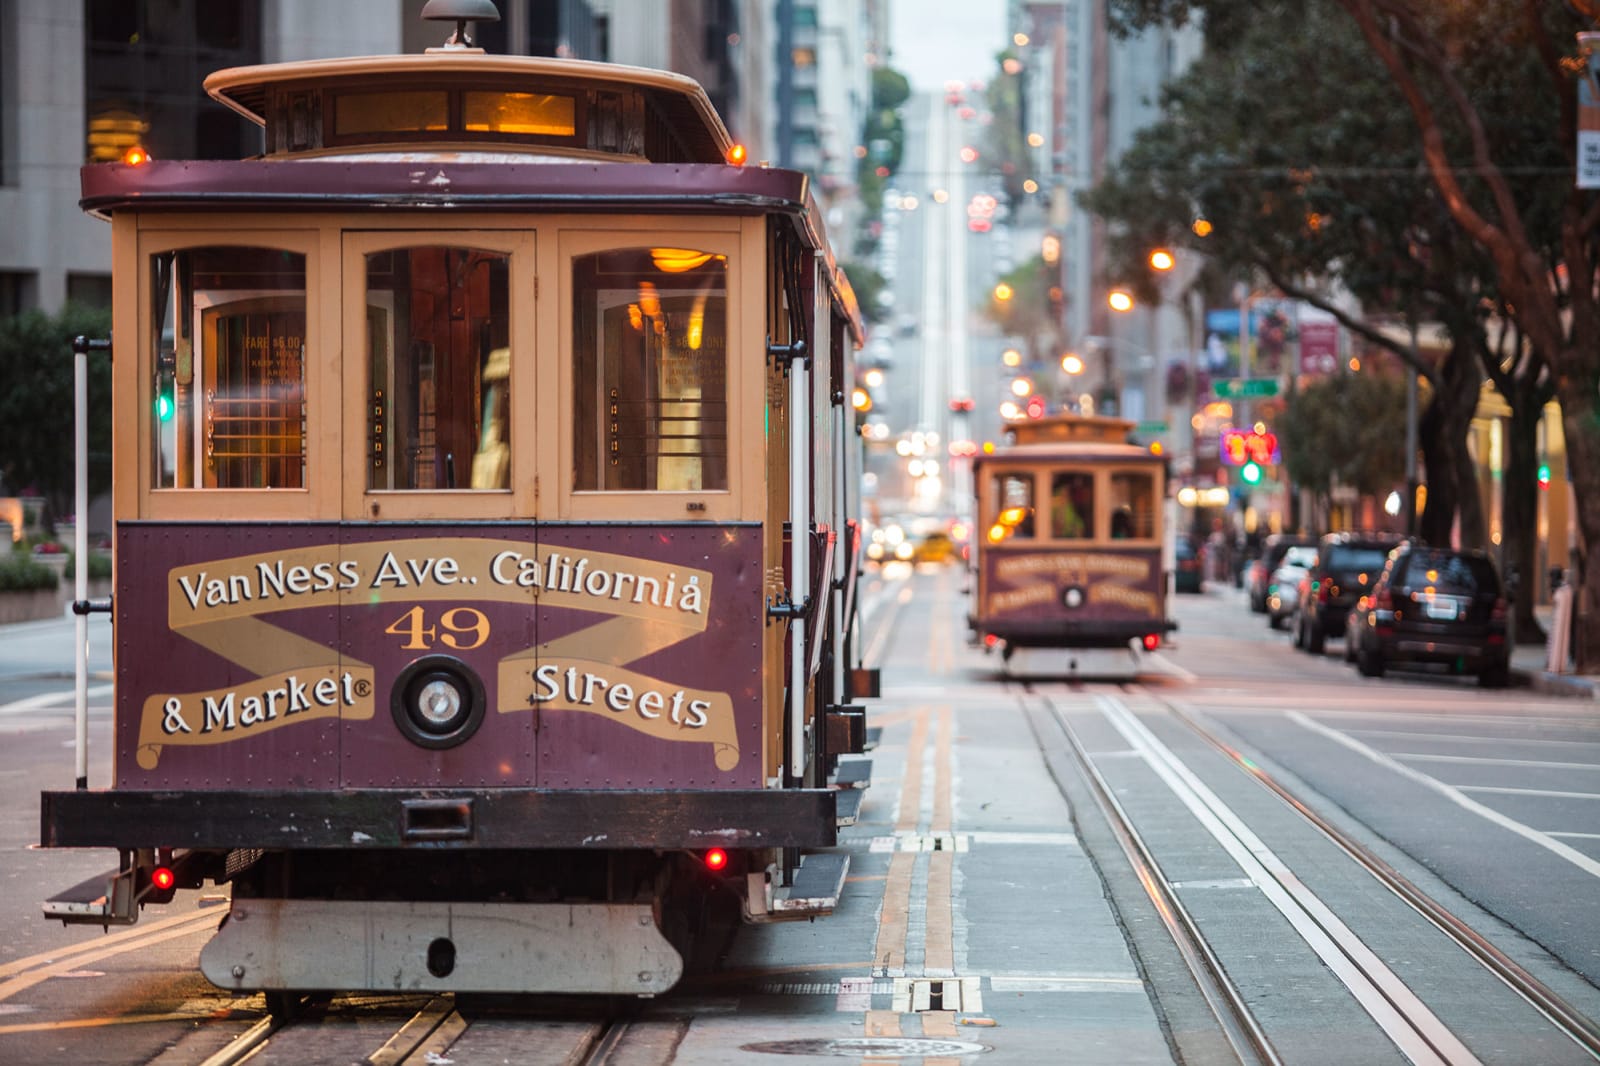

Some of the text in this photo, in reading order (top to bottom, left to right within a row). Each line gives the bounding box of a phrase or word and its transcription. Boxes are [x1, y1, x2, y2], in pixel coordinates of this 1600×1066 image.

[245, 336, 269, 349] FARE
[178, 572, 252, 610] Van
[256, 560, 360, 600] Ness
[490, 550, 703, 613] California
[385, 605, 491, 650] 49
[162, 696, 193, 735] &
[525, 664, 712, 730] Streets
